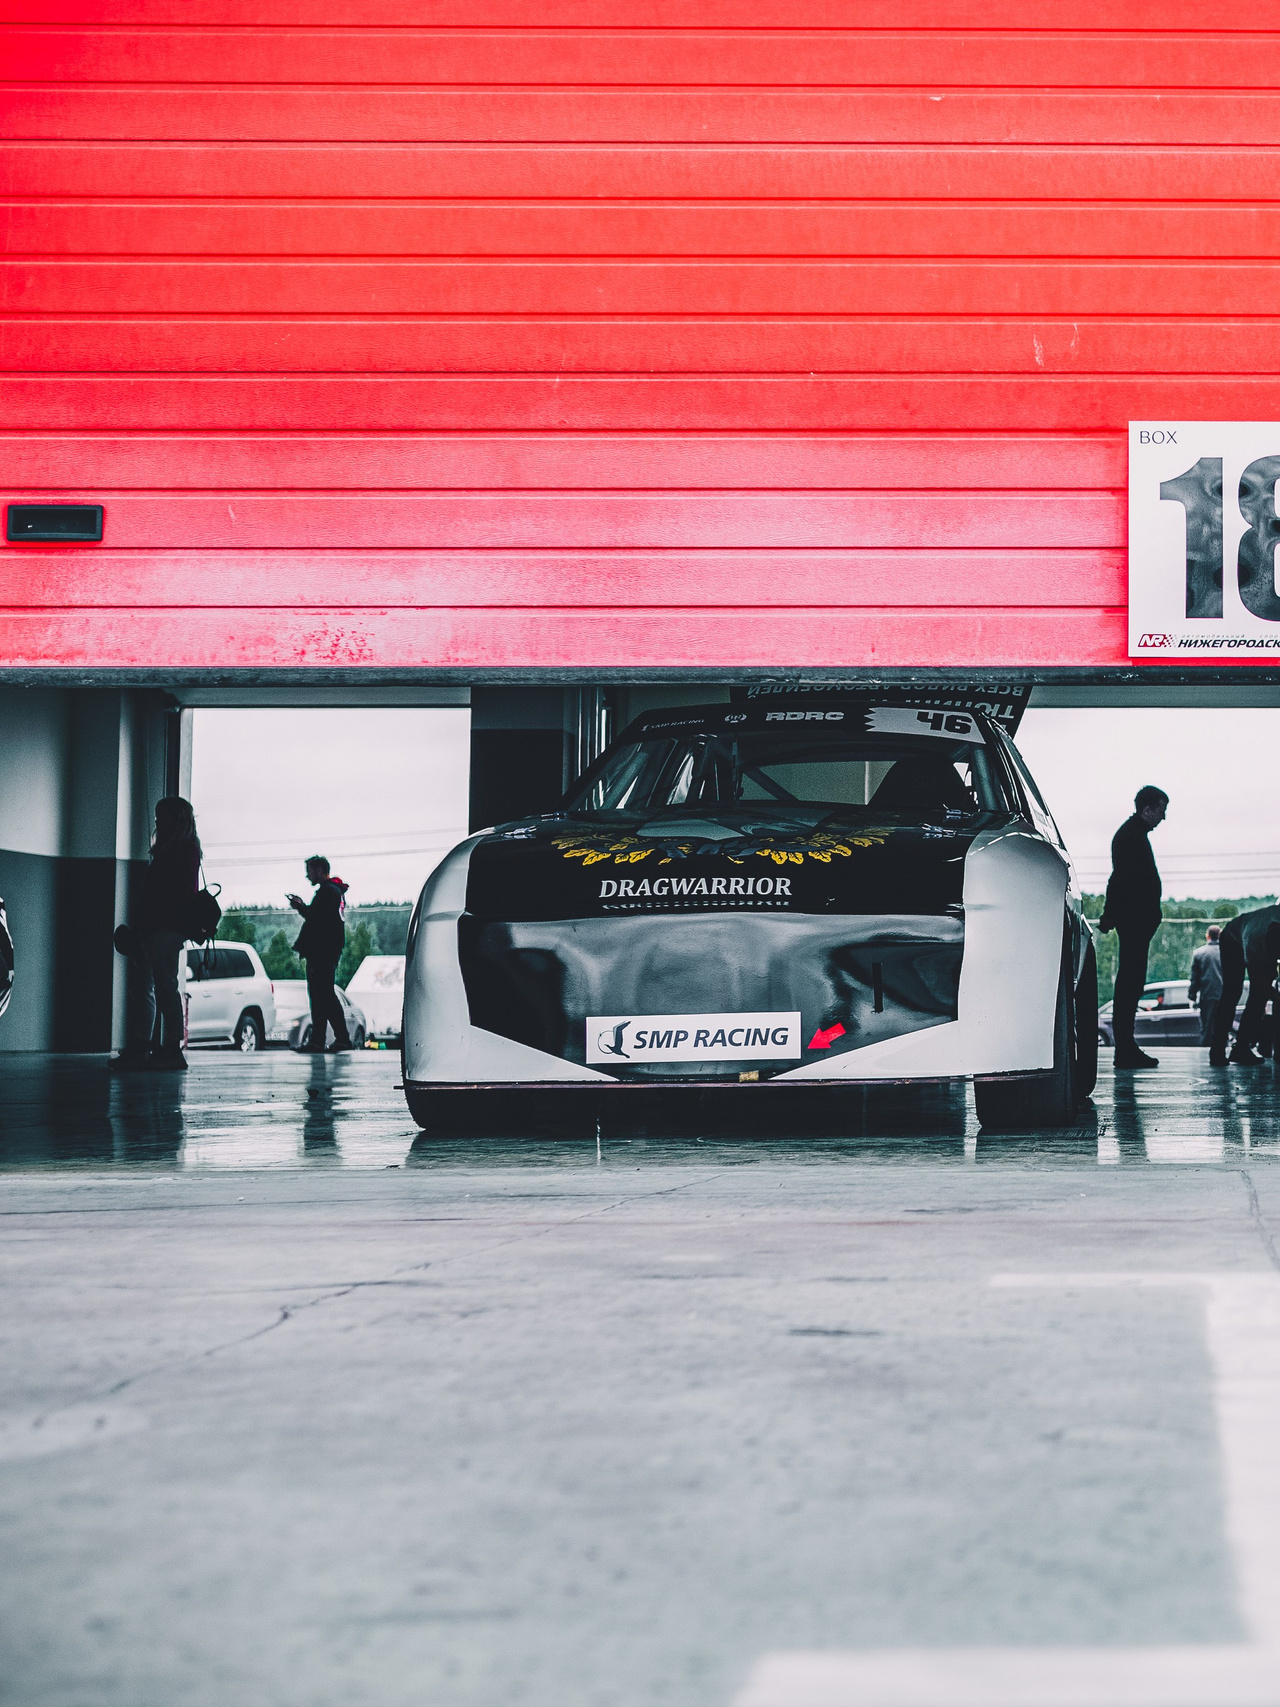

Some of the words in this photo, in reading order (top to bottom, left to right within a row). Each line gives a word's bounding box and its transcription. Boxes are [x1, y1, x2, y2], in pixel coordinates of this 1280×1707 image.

[1139, 430, 1178, 445] BOX
[670, 718, 705, 727] RACING
[765, 711, 845, 722] RDRC
[917, 710, 972, 734] 46
[599, 877, 793, 898] DRAGWARRIOR
[633, 1029, 689, 1049] SMP
[693, 1027, 789, 1048] RACING
